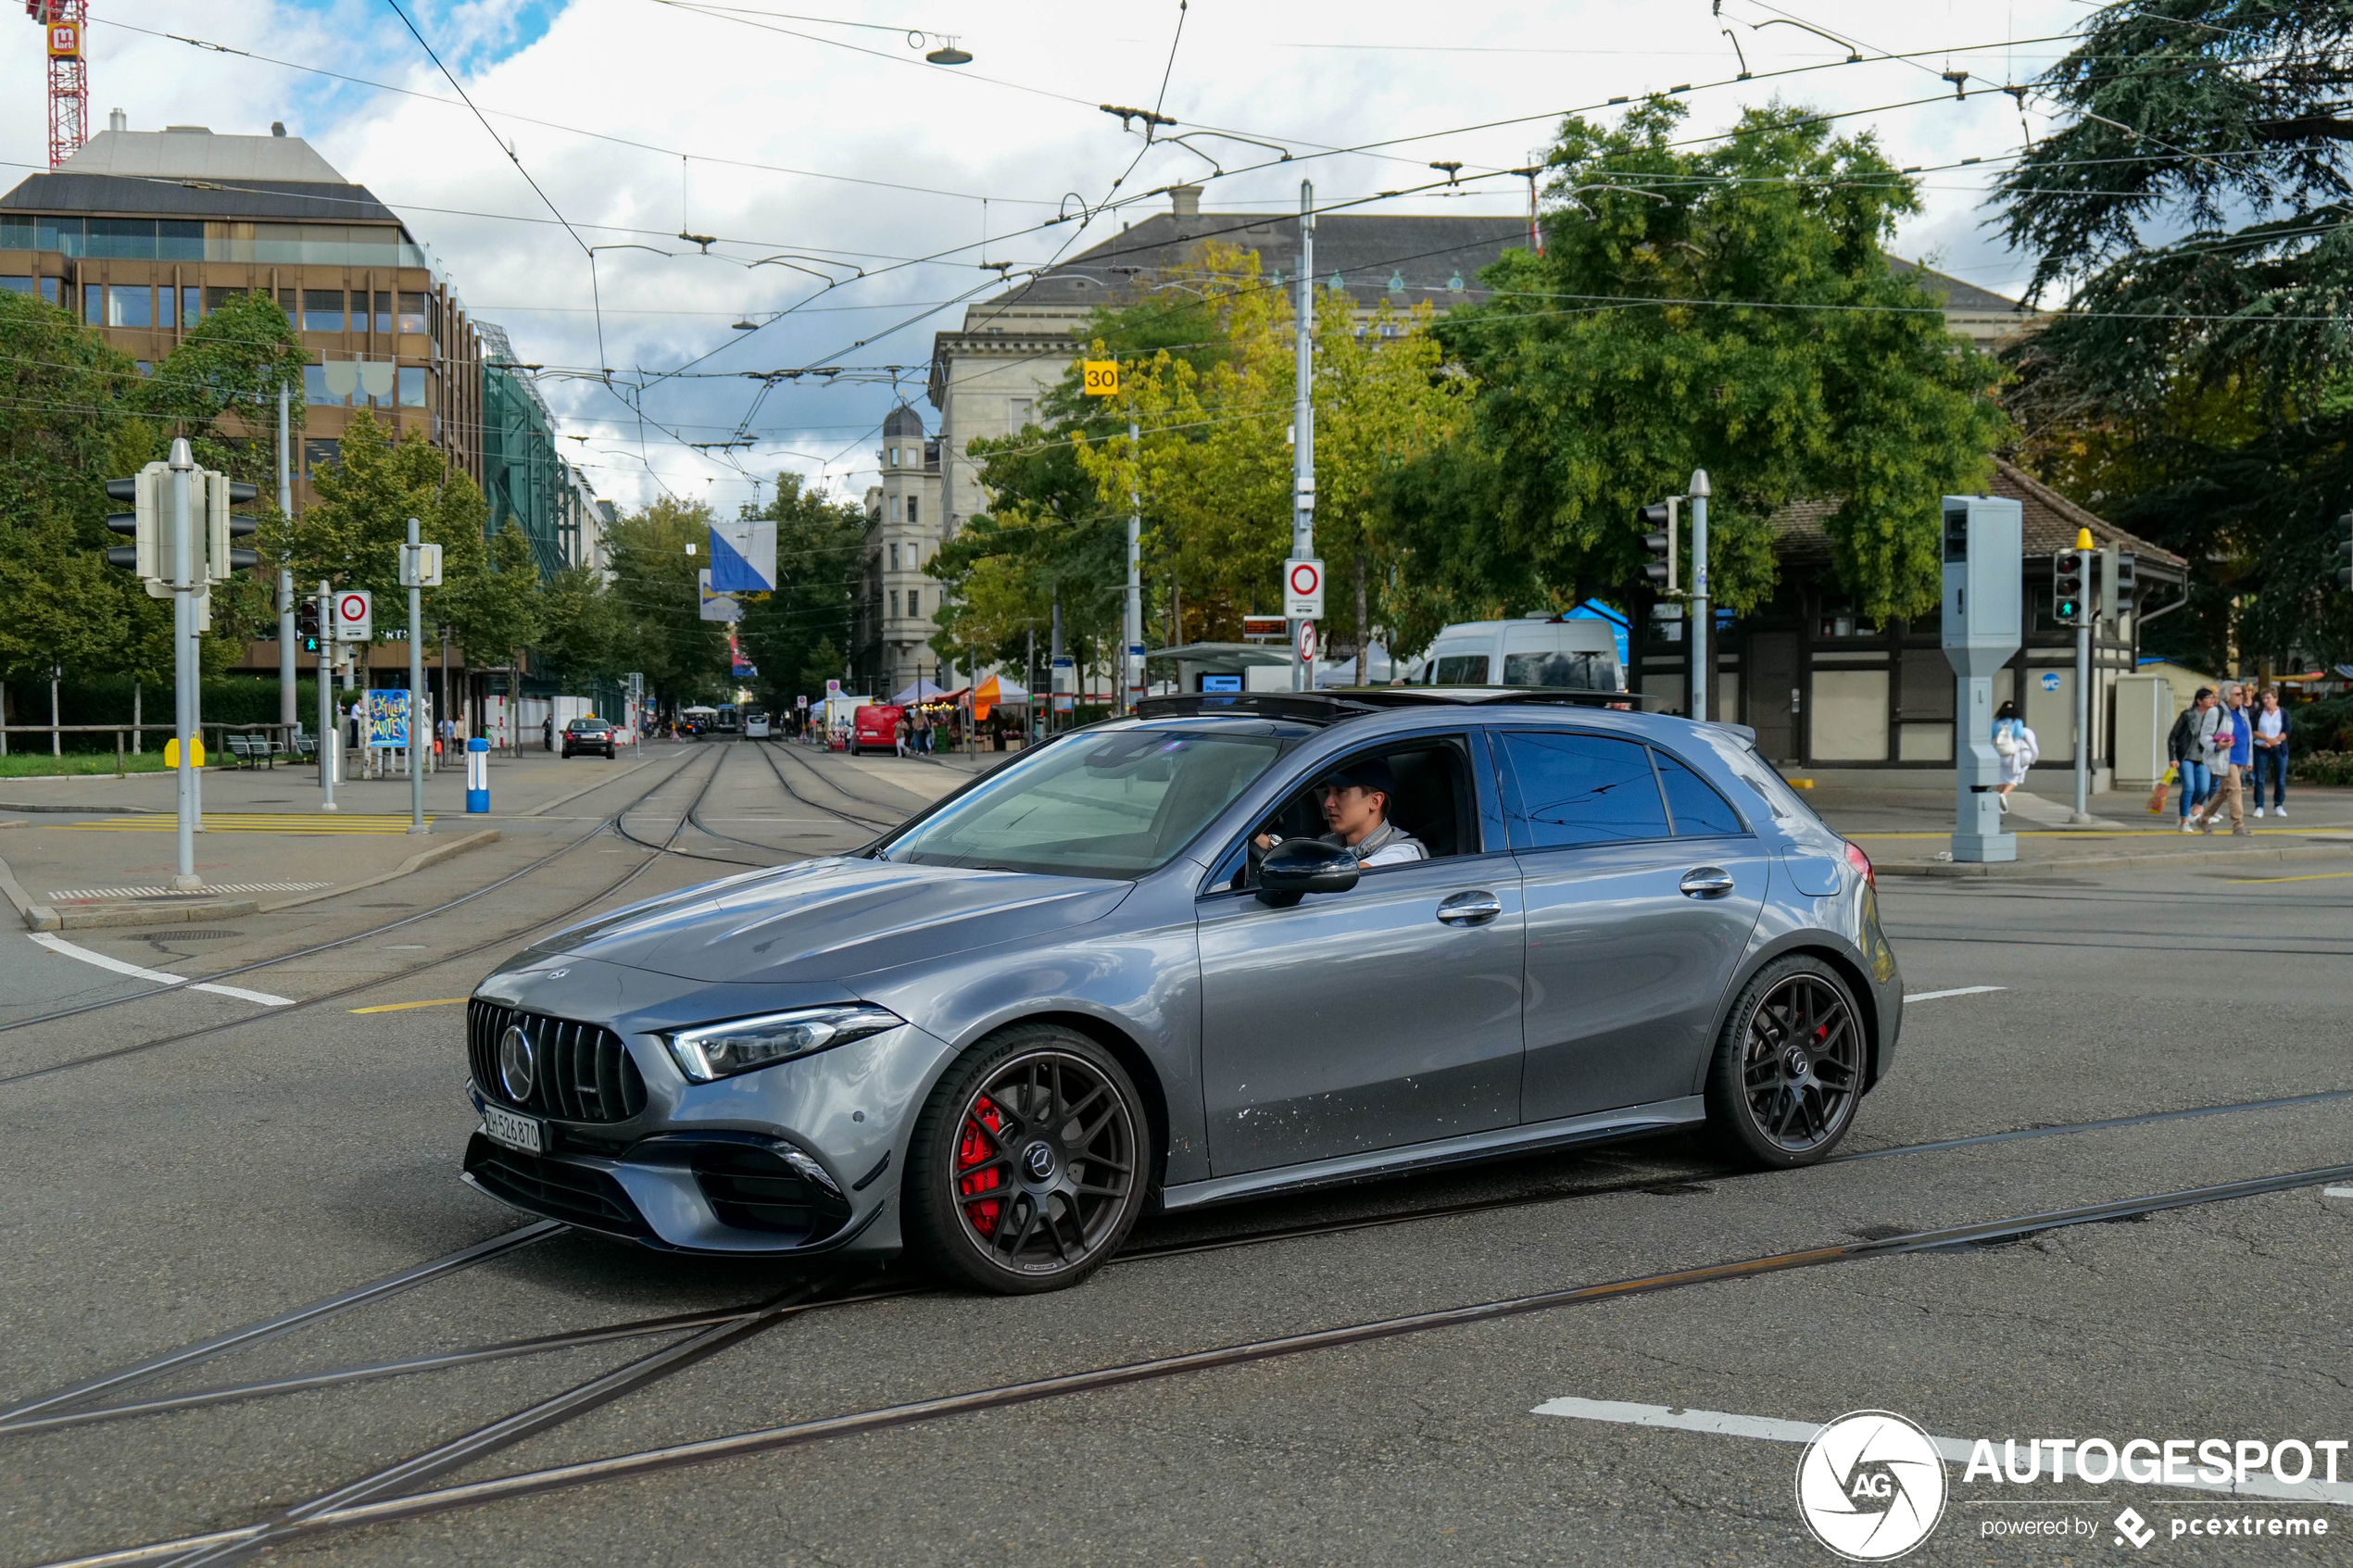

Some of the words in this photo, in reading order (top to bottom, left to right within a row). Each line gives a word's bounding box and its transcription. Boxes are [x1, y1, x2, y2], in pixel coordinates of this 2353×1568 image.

[53, 28, 74, 48] marti
[1088, 370, 1115, 387] 30
[2041, 678, 2060, 689] WC
